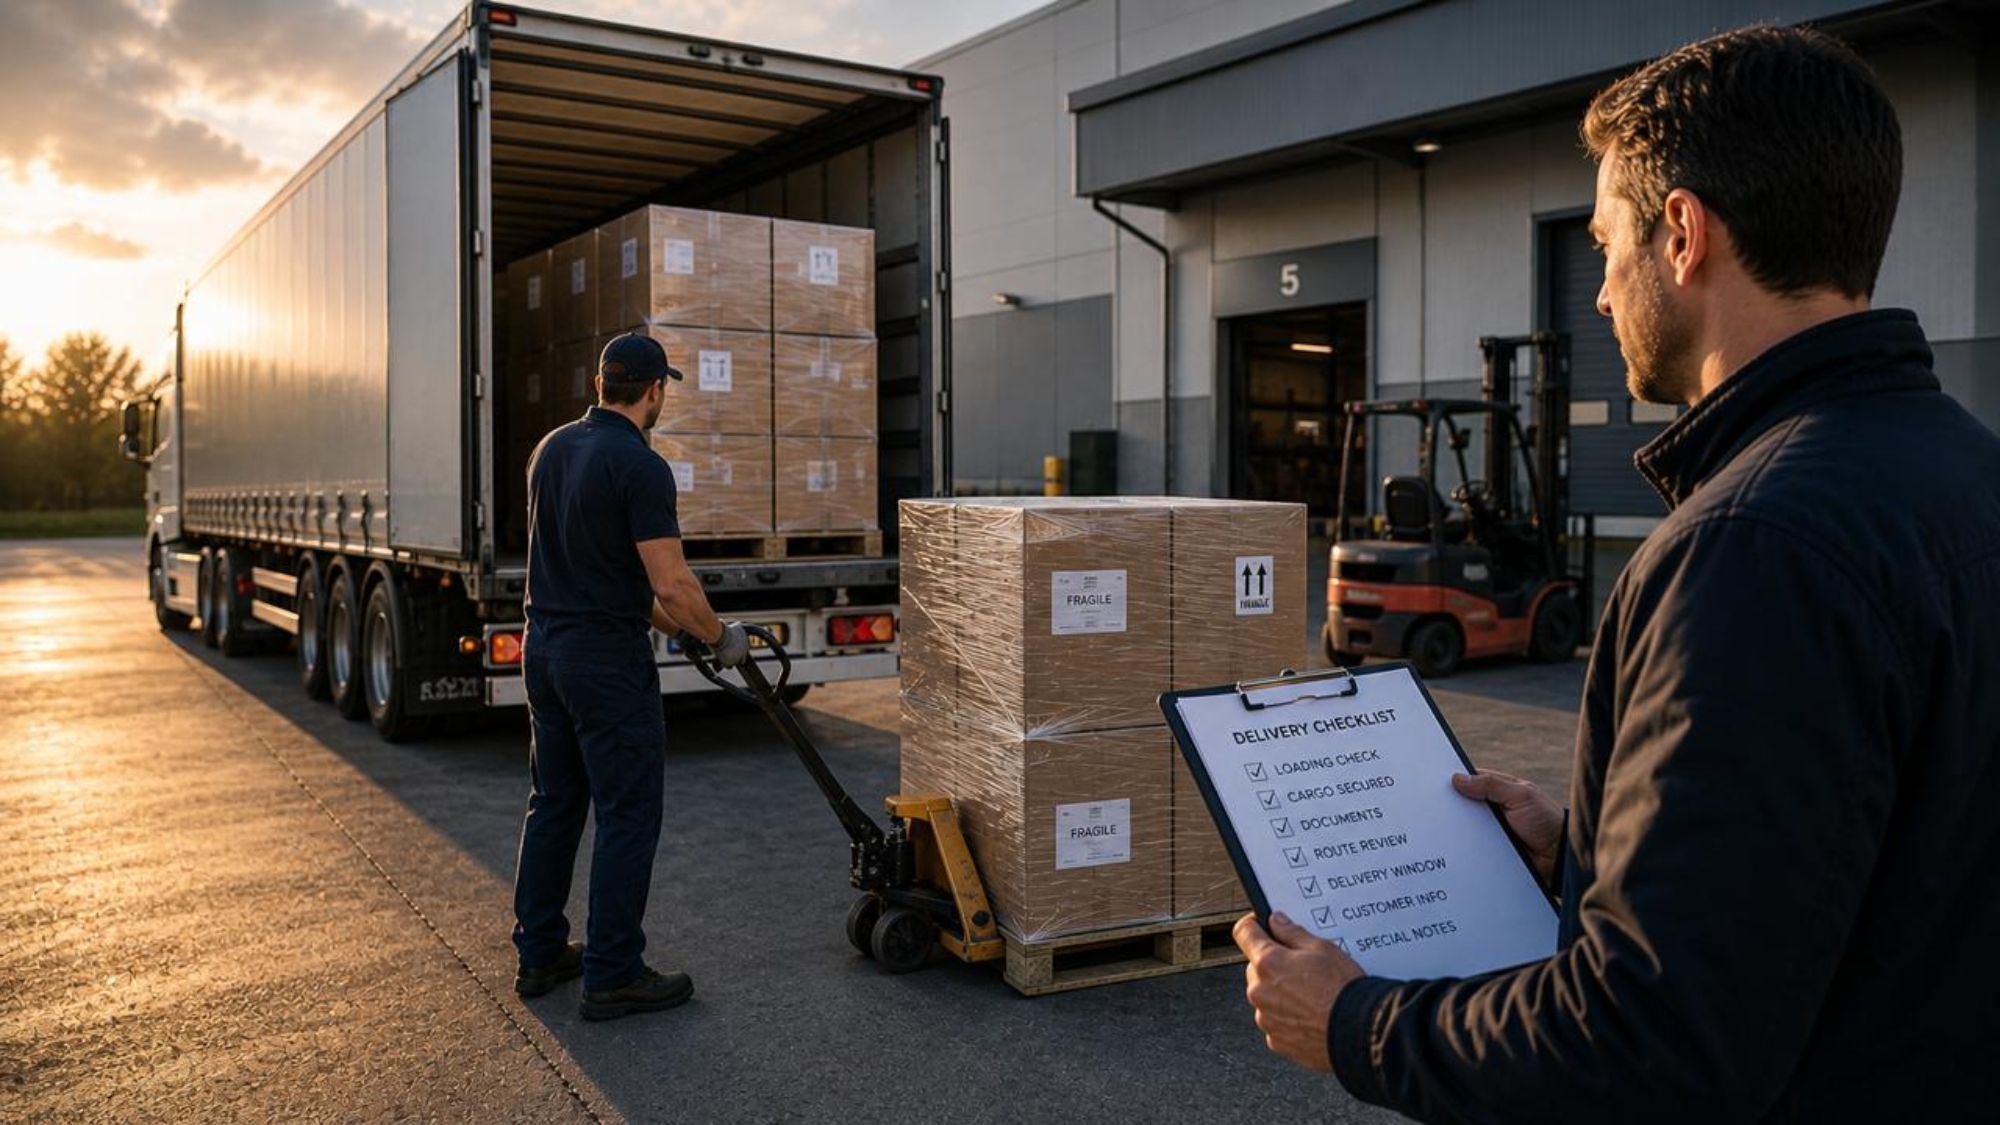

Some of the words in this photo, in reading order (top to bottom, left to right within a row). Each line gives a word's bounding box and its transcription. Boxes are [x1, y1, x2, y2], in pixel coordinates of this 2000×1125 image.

[1281, 264, 1299, 296] 5
[1066, 594, 1112, 606] FRAGILE
[1232, 722, 1309, 745] DELIVERY
[1313, 709, 1397, 733] CHECKLIST
[1274, 757, 1334, 776] LOADING
[1336, 749, 1380, 766] CHECK
[1287, 785, 1334, 803] CARGO
[1336, 776, 1395, 795] SECURED
[1070, 824, 1117, 838] FRAGILE
[1300, 807, 1383, 831] DOCUMENTS
[1313, 842, 1359, 860] ROUTE
[1359, 833, 1408, 851] REVIEW
[1327, 868, 1388, 890] DELIVERY
[1390, 857, 1447, 878] WINDOW
[1341, 895, 1415, 920] CUSTOMER
[1415, 889, 1448, 907] INFO
[1356, 932, 1411, 952] SPECIAL
[1412, 920, 1457, 940] NOTES
